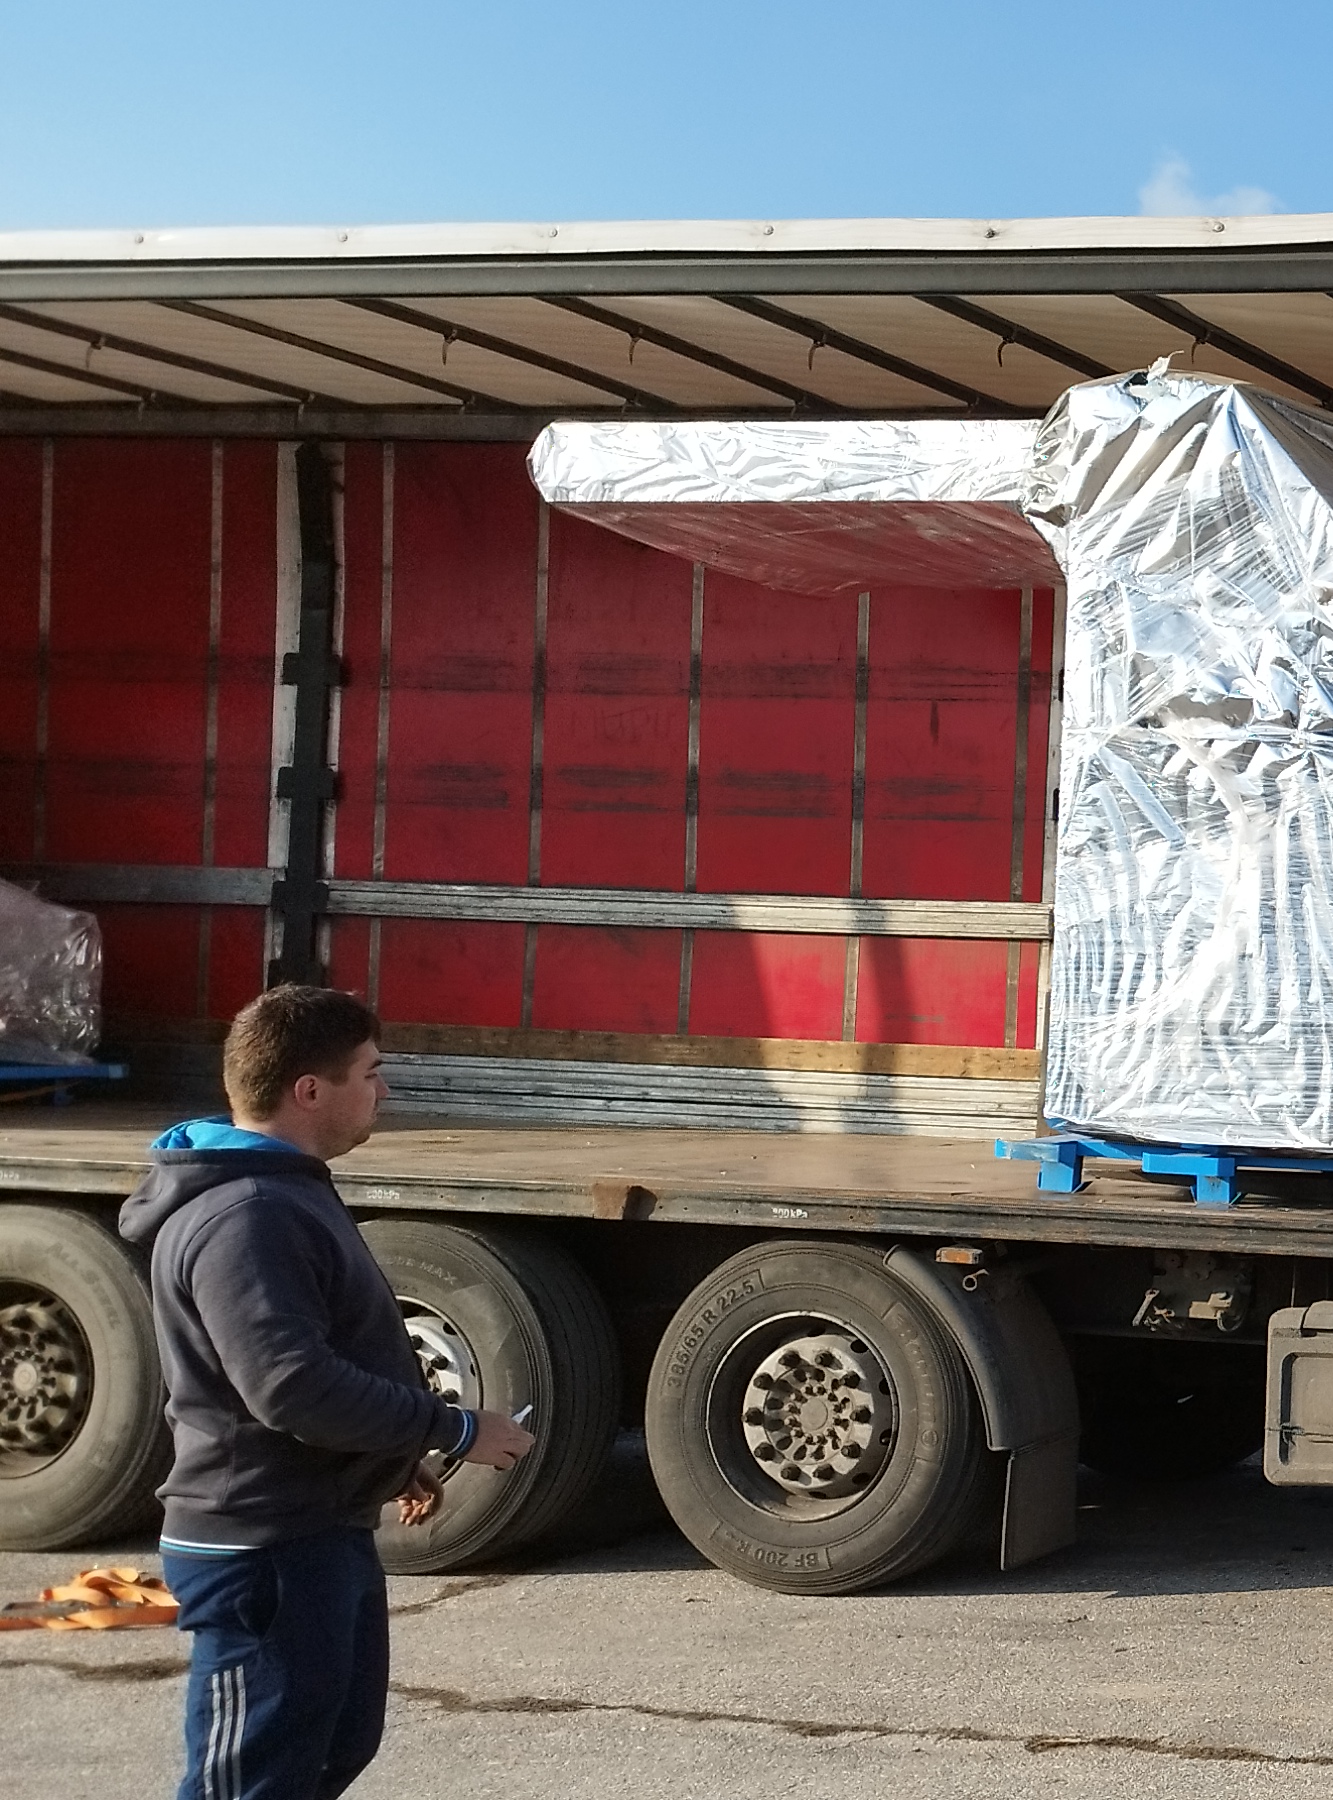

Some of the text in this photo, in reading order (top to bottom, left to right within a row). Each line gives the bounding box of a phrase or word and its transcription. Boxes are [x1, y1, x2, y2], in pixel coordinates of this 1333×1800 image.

[667, 1323, 705, 1388] 385/65
[701, 1308, 718, 1326] R
[716, 1279, 755, 1311] 22.5
[753, 1548, 790, 1567] 200
